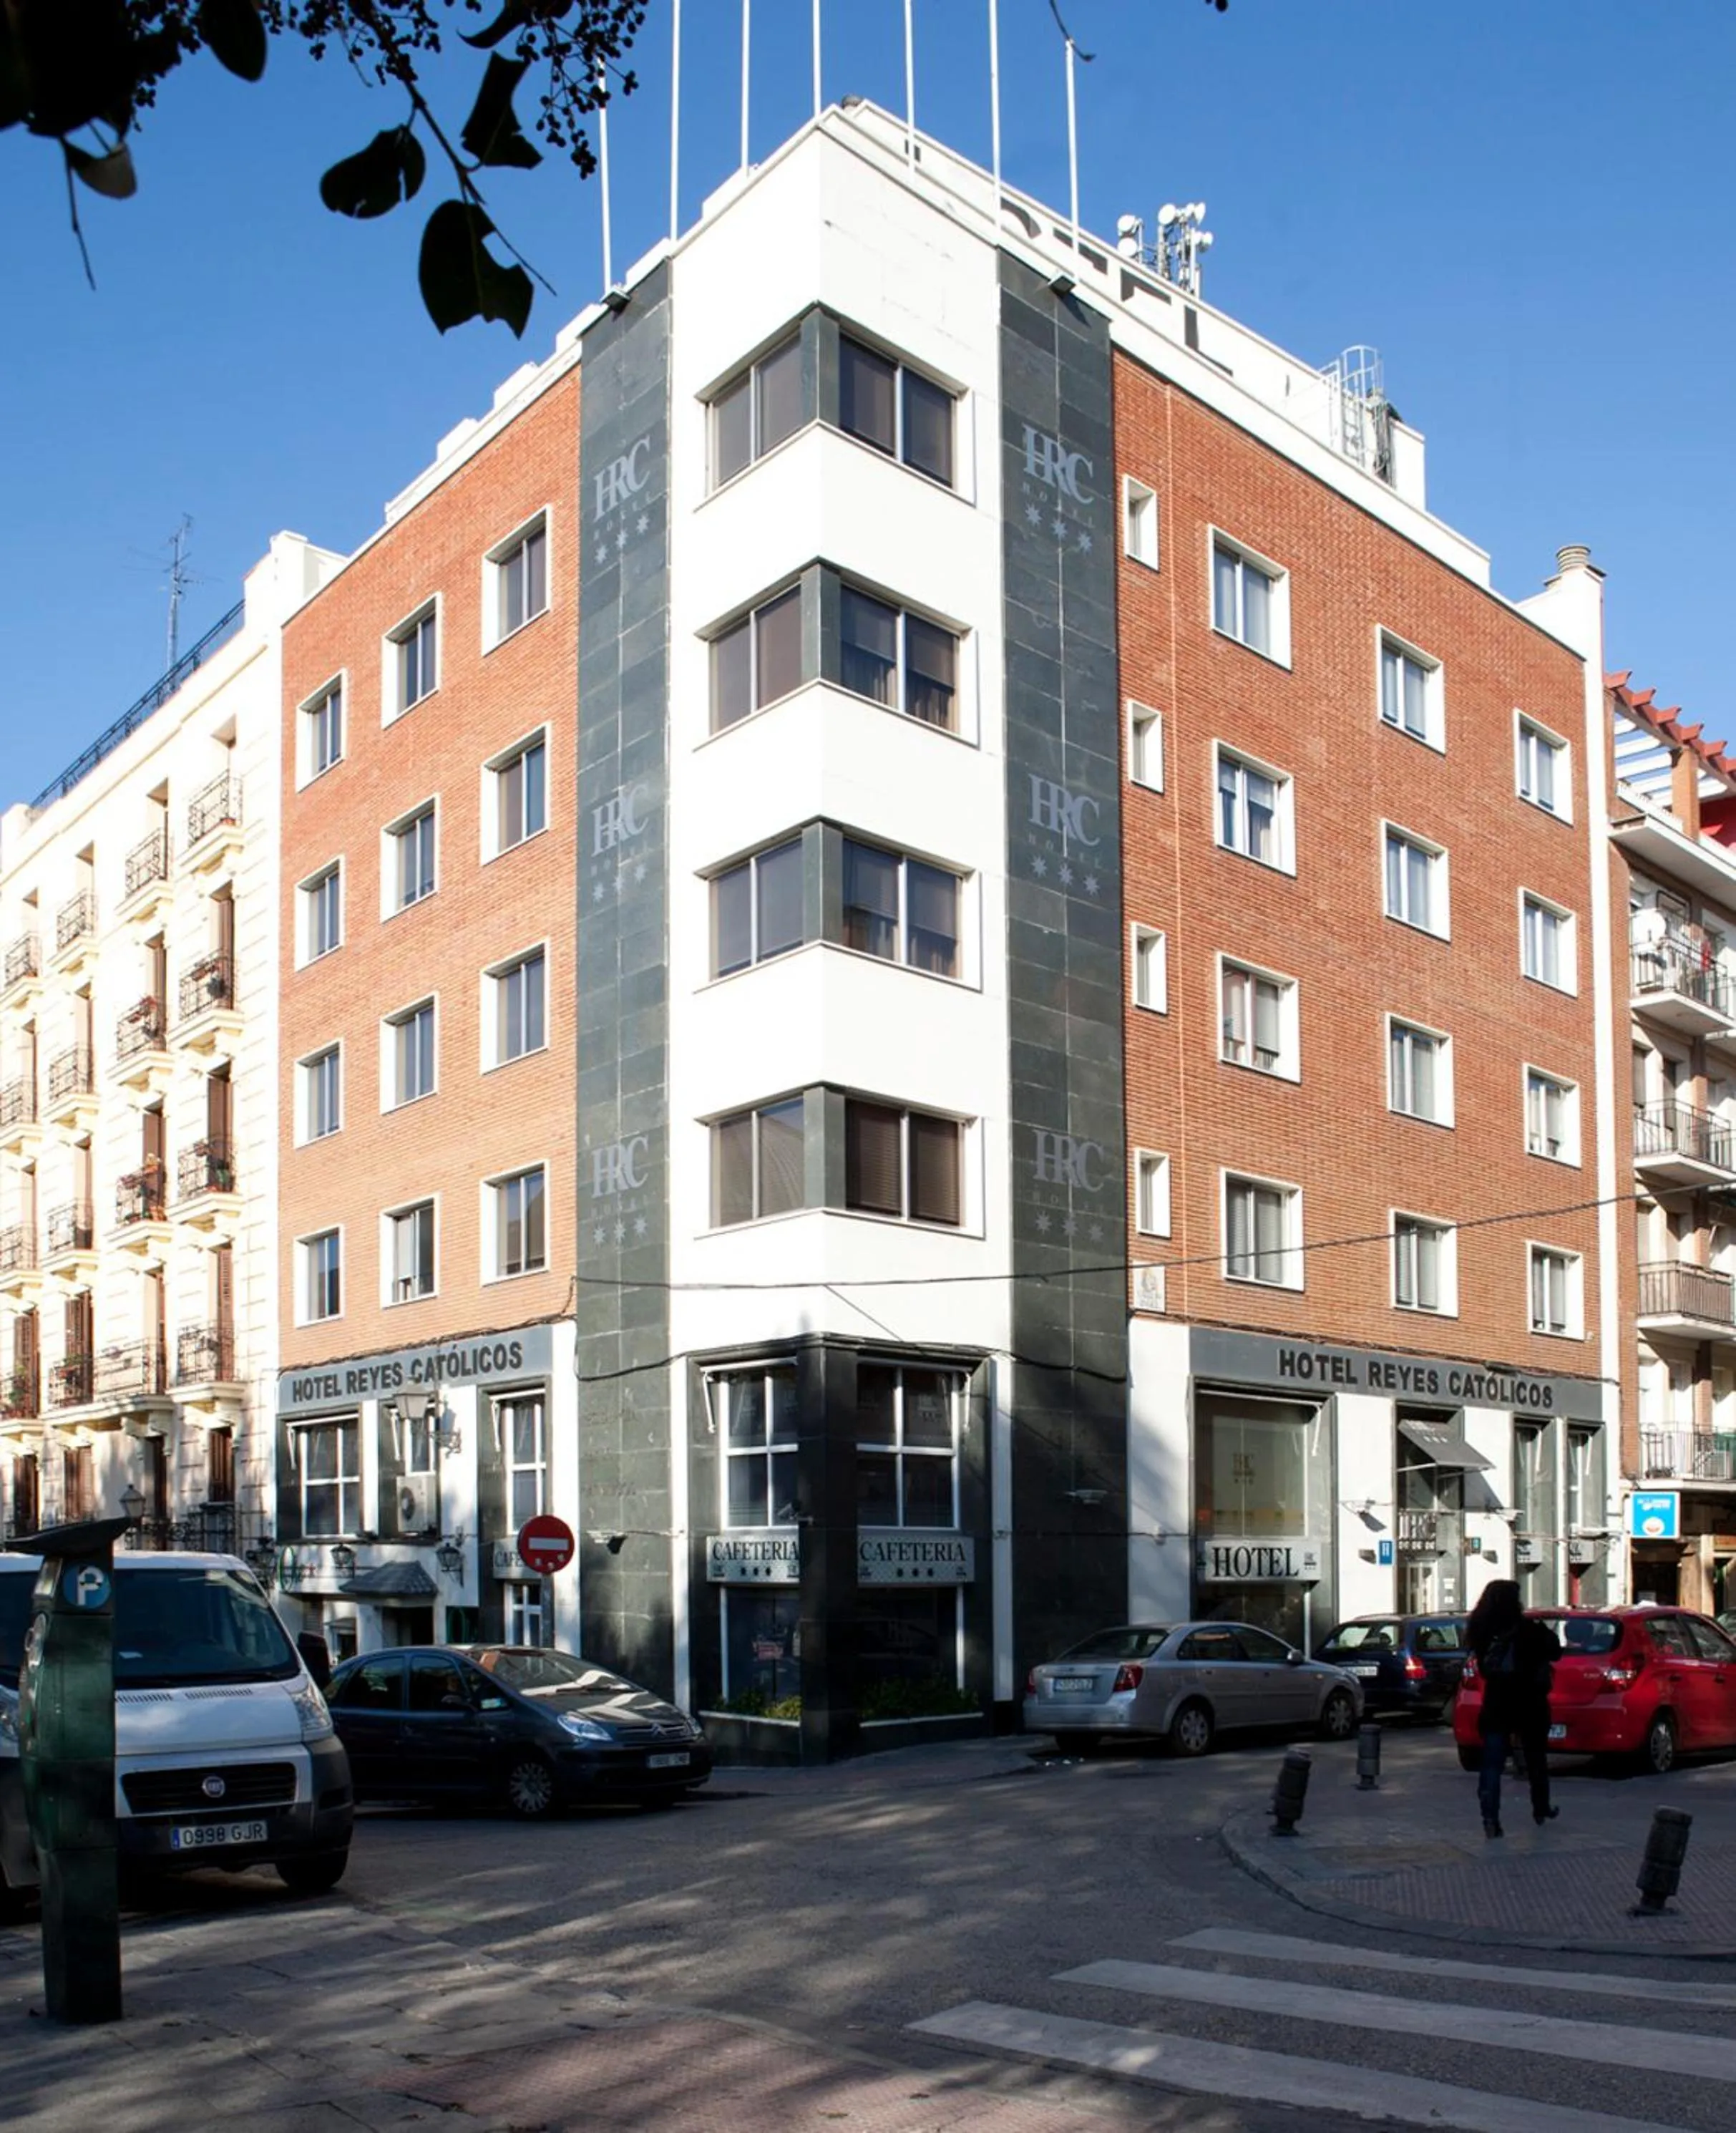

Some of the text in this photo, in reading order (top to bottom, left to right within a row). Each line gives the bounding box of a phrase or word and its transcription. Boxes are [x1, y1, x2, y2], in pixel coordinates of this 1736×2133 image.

[593, 435, 650, 523] HRC
[1021, 422, 1095, 505] HRC
[591, 782, 649, 857] HRC
[1028, 772, 1101, 847] HRC
[590, 1134, 649, 1199] HRC
[1031, 1128, 1105, 1192] HRC
[292, 1341, 523, 1403] HOTEL REYES CATÓLICOS
[1279, 1348, 1554, 1409] HOTEL REYES CATÓLICOS
[712, 1540, 800, 1561] CAFETERIA
[859, 1540, 966, 1562] CAFETERIA
[1211, 1545, 1300, 1578] HOTEL
[77, 1564, 104, 1606] P
[183, 1822, 264, 1845] 0998 GJR
